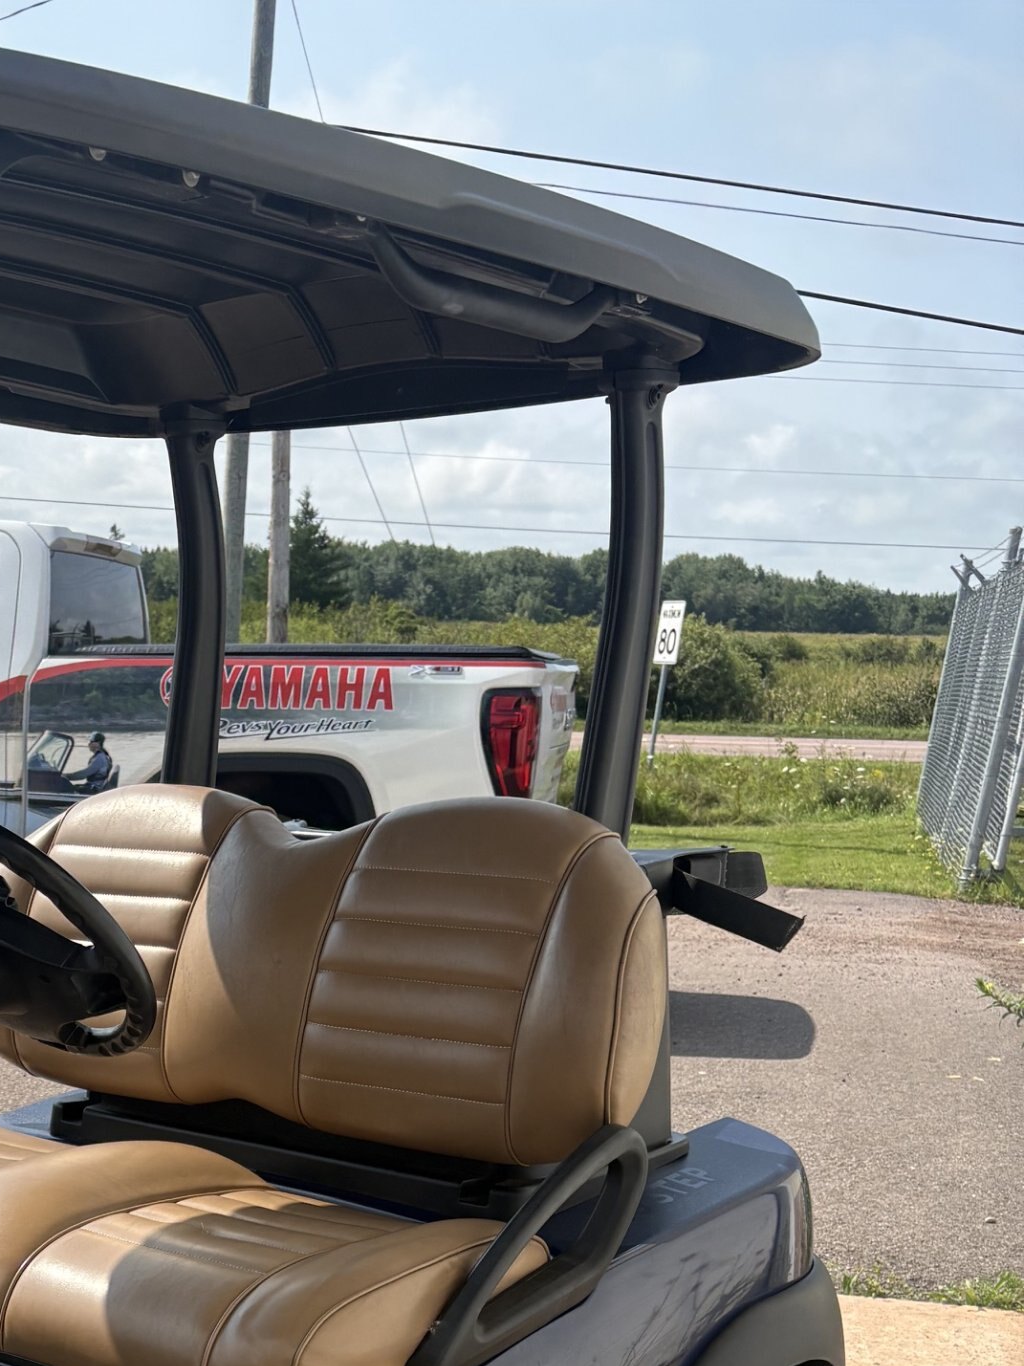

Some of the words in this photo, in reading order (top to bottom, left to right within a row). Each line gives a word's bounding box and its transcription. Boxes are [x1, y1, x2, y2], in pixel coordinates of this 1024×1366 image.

[658, 628, 677, 655] 80
[220, 665, 395, 711] YAMAHA
[264, 719, 315, 740] Your
[314, 717, 376, 732] Heart
